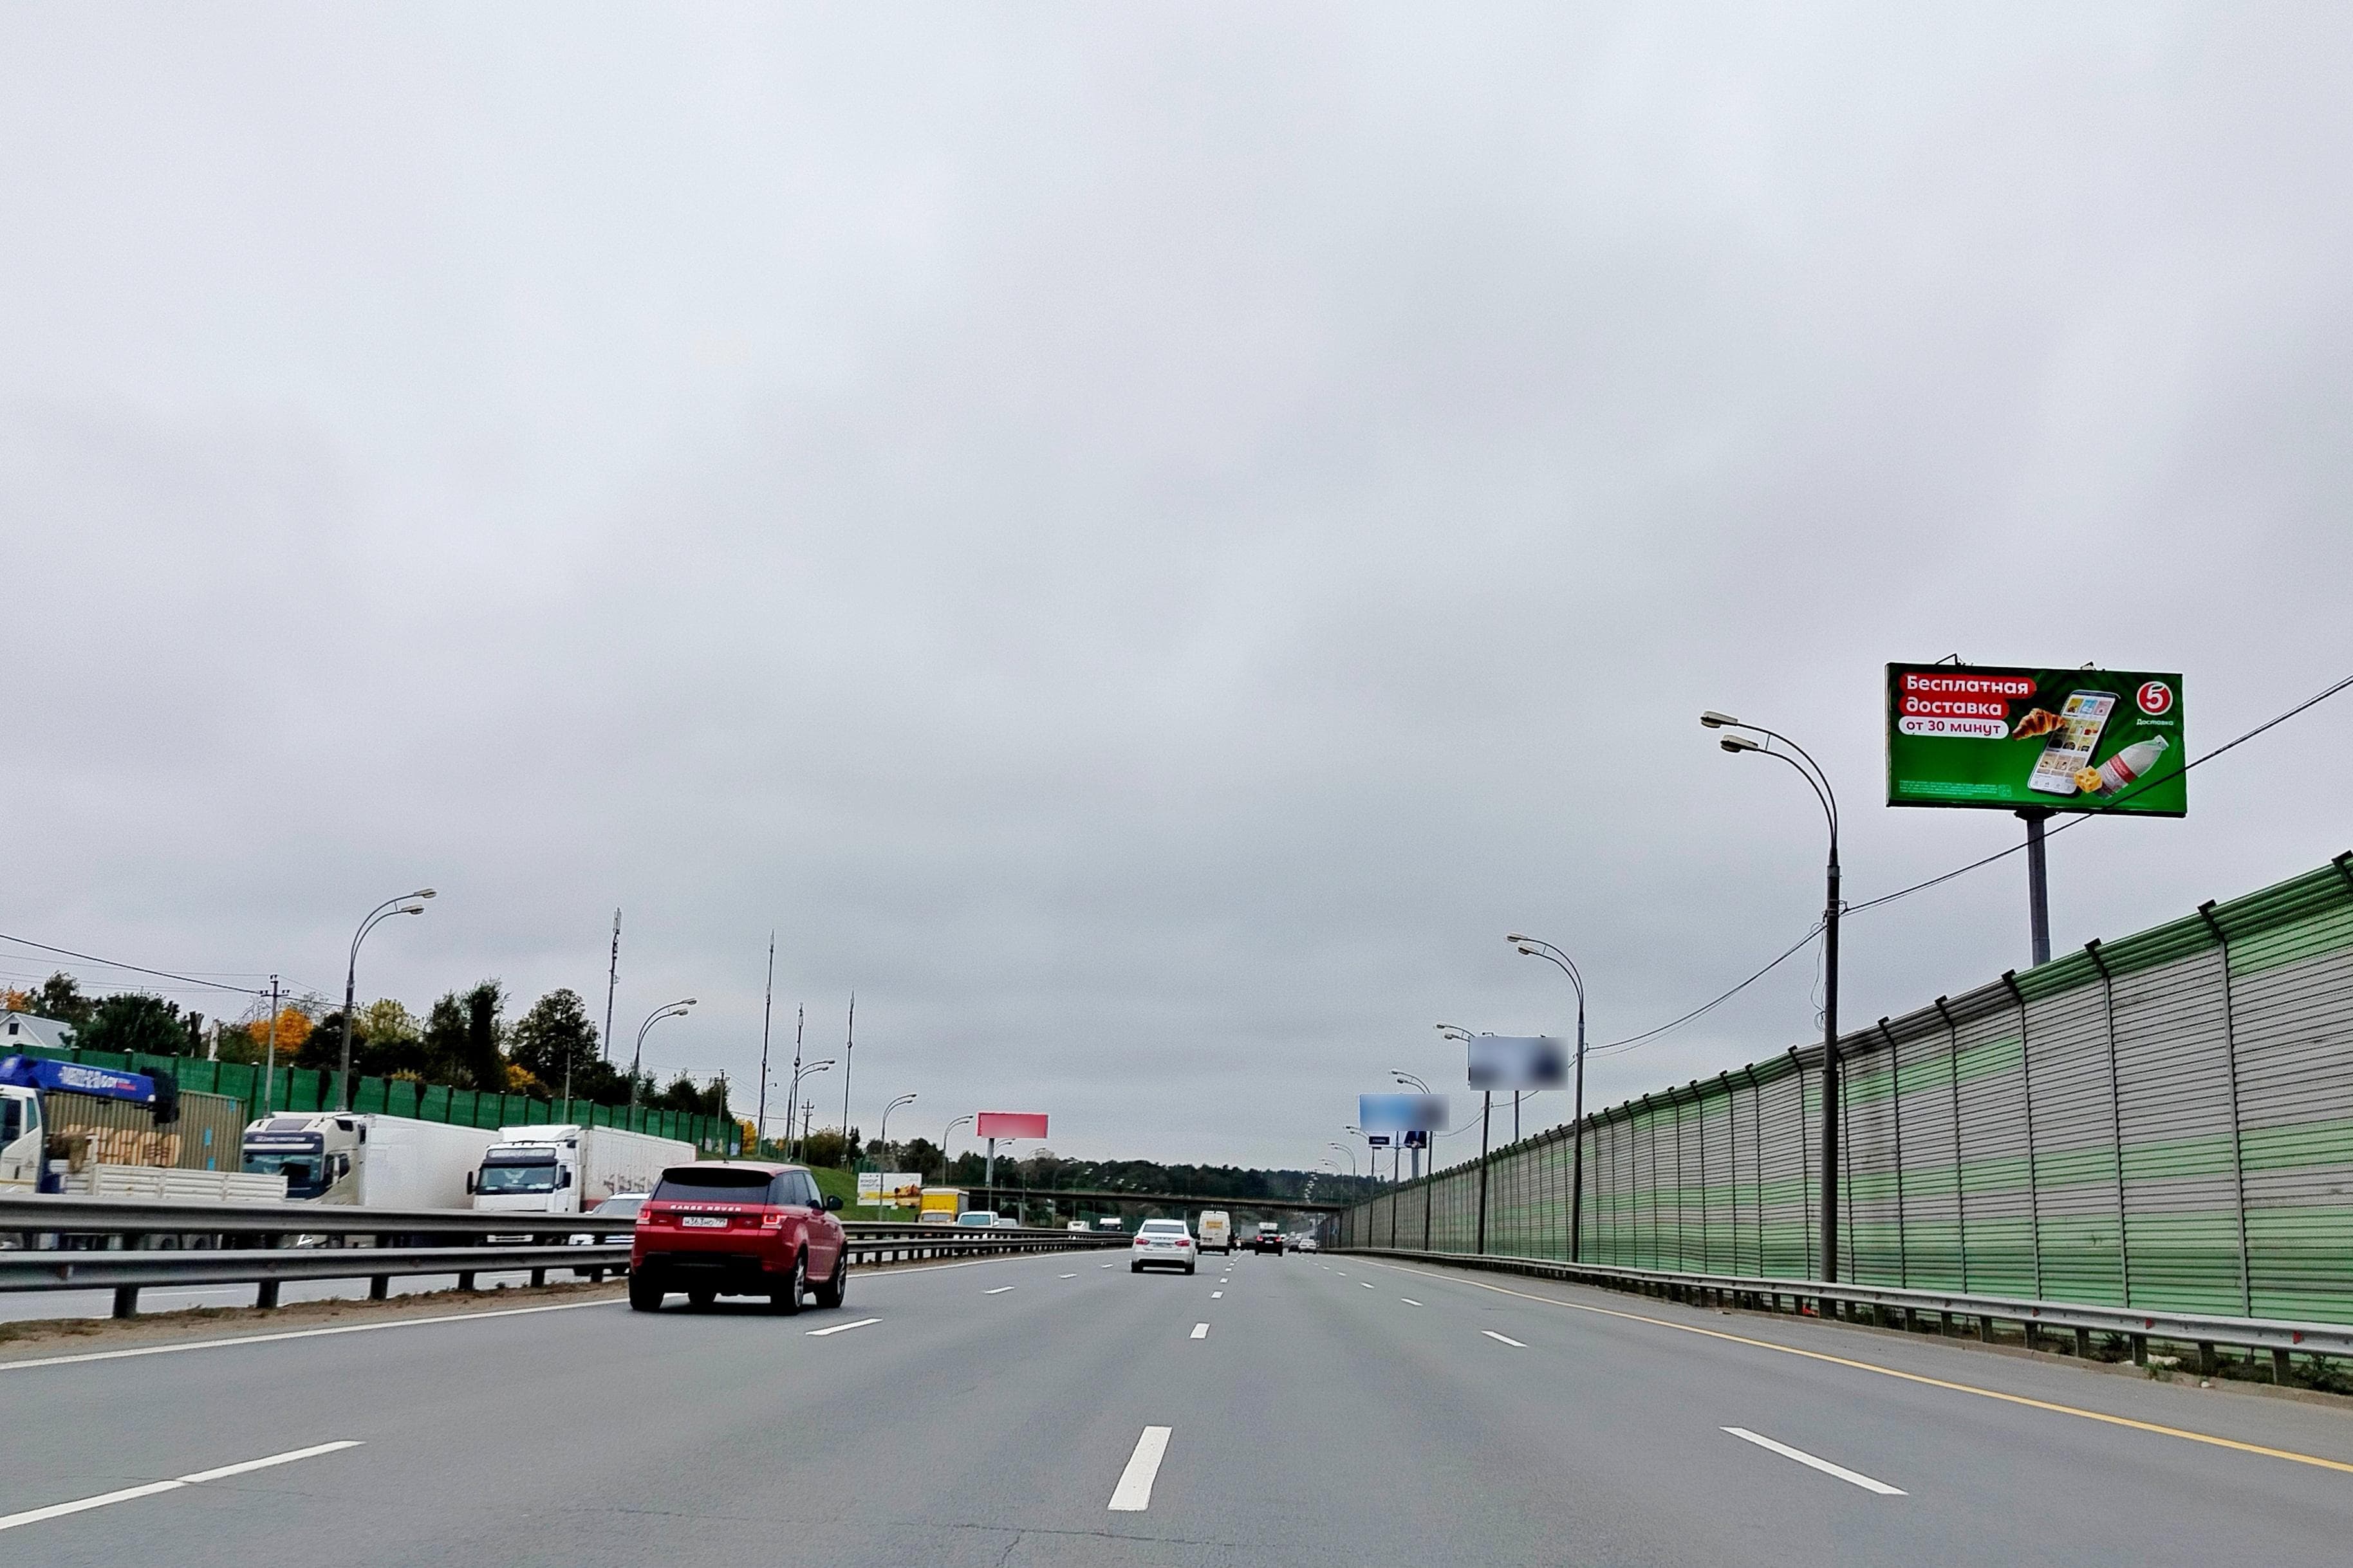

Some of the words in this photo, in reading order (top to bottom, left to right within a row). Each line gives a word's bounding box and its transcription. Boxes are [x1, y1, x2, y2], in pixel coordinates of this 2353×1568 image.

[1907, 675, 2028, 694] Бесплатная
[1906, 696, 2002, 715] доставка
[2146, 683, 2165, 709] 5
[1906, 721, 1924, 730] от
[1928, 721, 1945, 732] 30
[1950, 723, 2001, 736] минут
